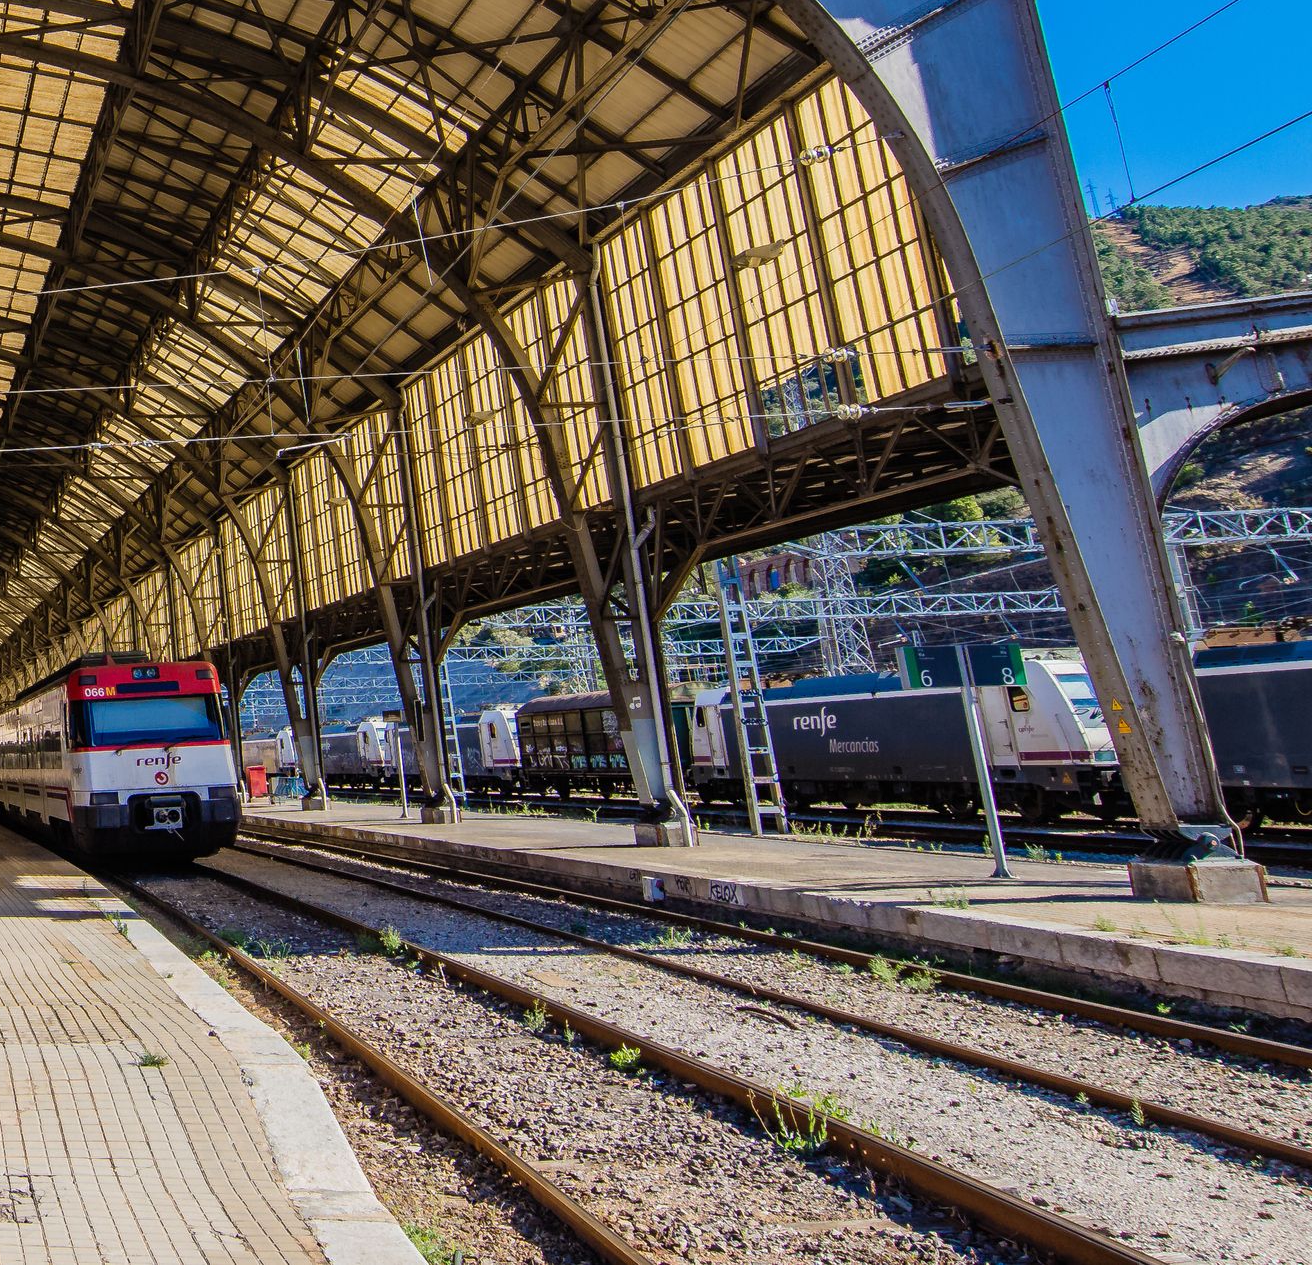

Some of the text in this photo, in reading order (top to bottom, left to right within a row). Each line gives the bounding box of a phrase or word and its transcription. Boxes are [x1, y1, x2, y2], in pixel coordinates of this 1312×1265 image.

[920, 669, 933, 687] 6
[1001, 667, 1015, 685] 8
[793, 706, 837, 737] renfe
[136, 751, 182, 770] renfe
